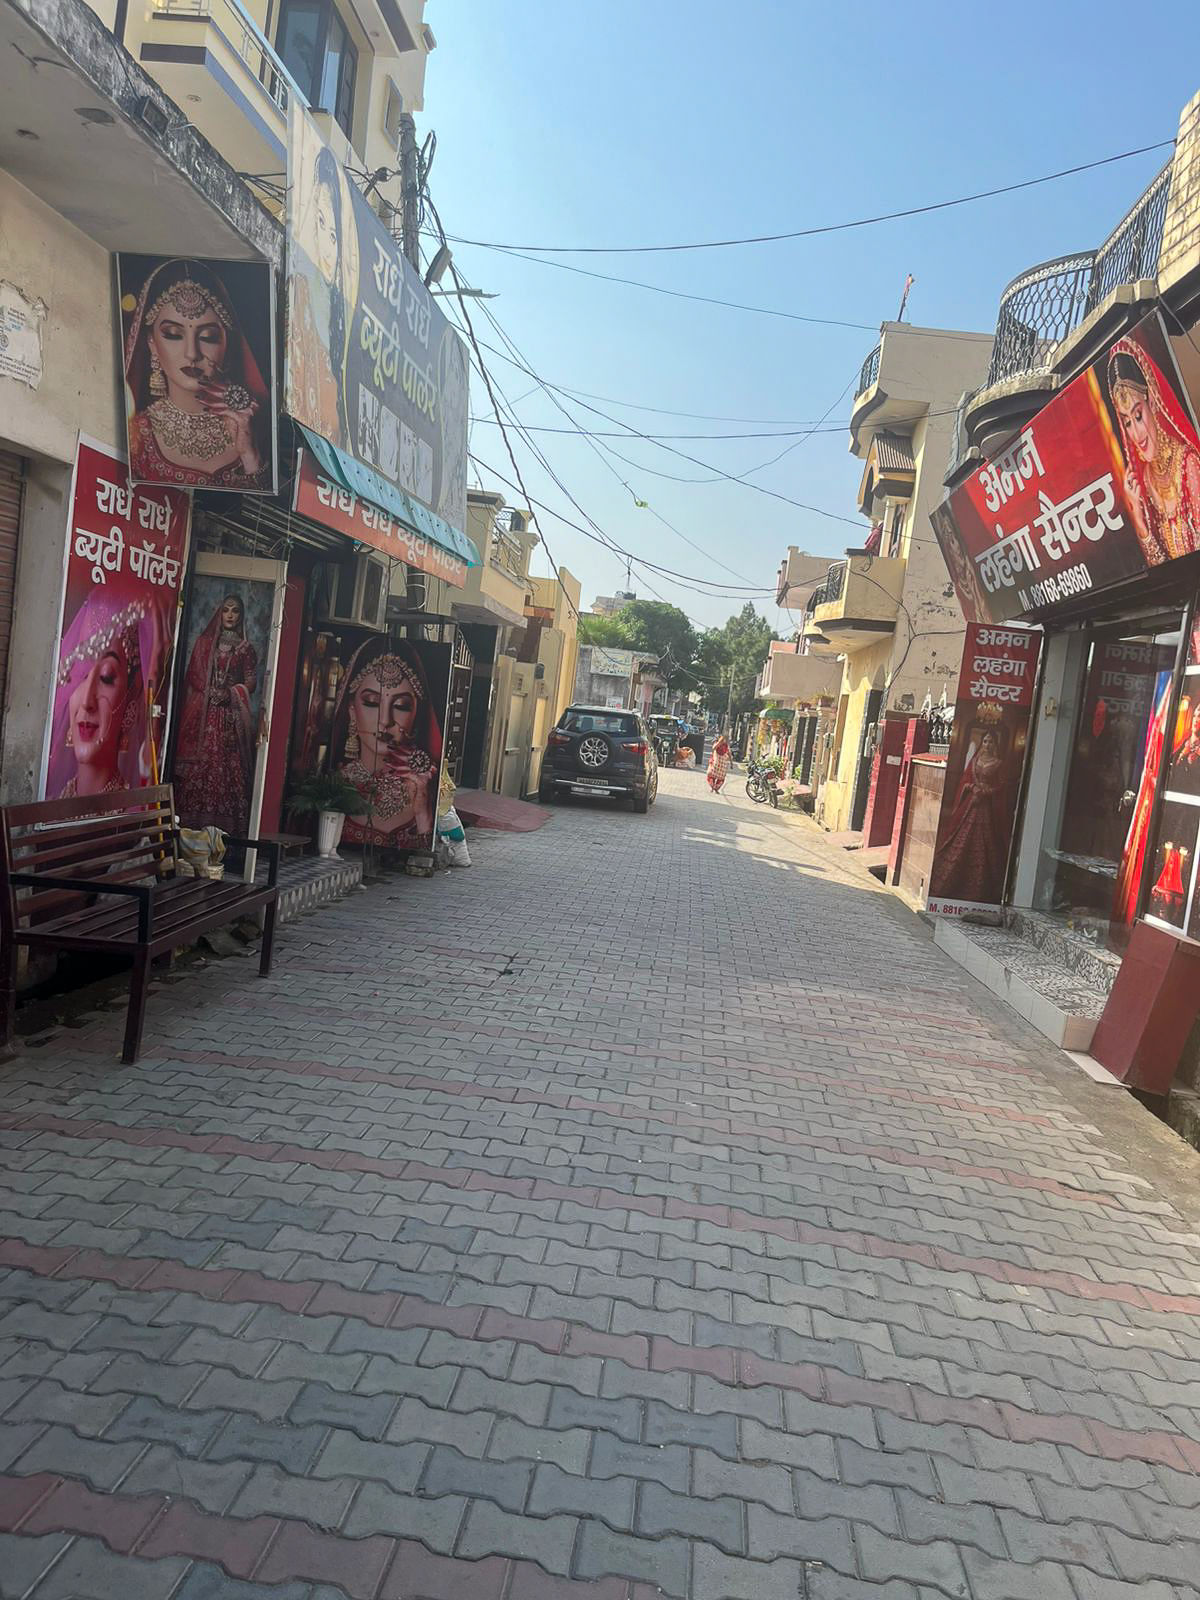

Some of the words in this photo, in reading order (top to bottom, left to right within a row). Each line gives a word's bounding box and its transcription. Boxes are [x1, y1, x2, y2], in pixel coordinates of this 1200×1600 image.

[373, 237, 404, 315] राधे
[406, 283, 431, 350] राधे
[361, 302, 400, 391] ब्यूटी
[979, 426, 1045, 513] अमन
[96, 477, 135, 521] राधे
[138, 494, 172, 537] राधे
[316, 475, 358, 518] राध
[362, 501, 396, 536] राध
[975, 524, 1041, 593] लहंगा
[1033, 473, 1124, 561] सैन्टर
[75, 525, 125, 585] ब्यूटी
[1018, 591, 1033, 612] M.
[1031, 562, 1093, 608] 88168-69860
[973, 652, 1027, 677] लहंगा
[976, 628, 1032, 649] अमन
[970, 675, 1023, 702] सैन्टर
